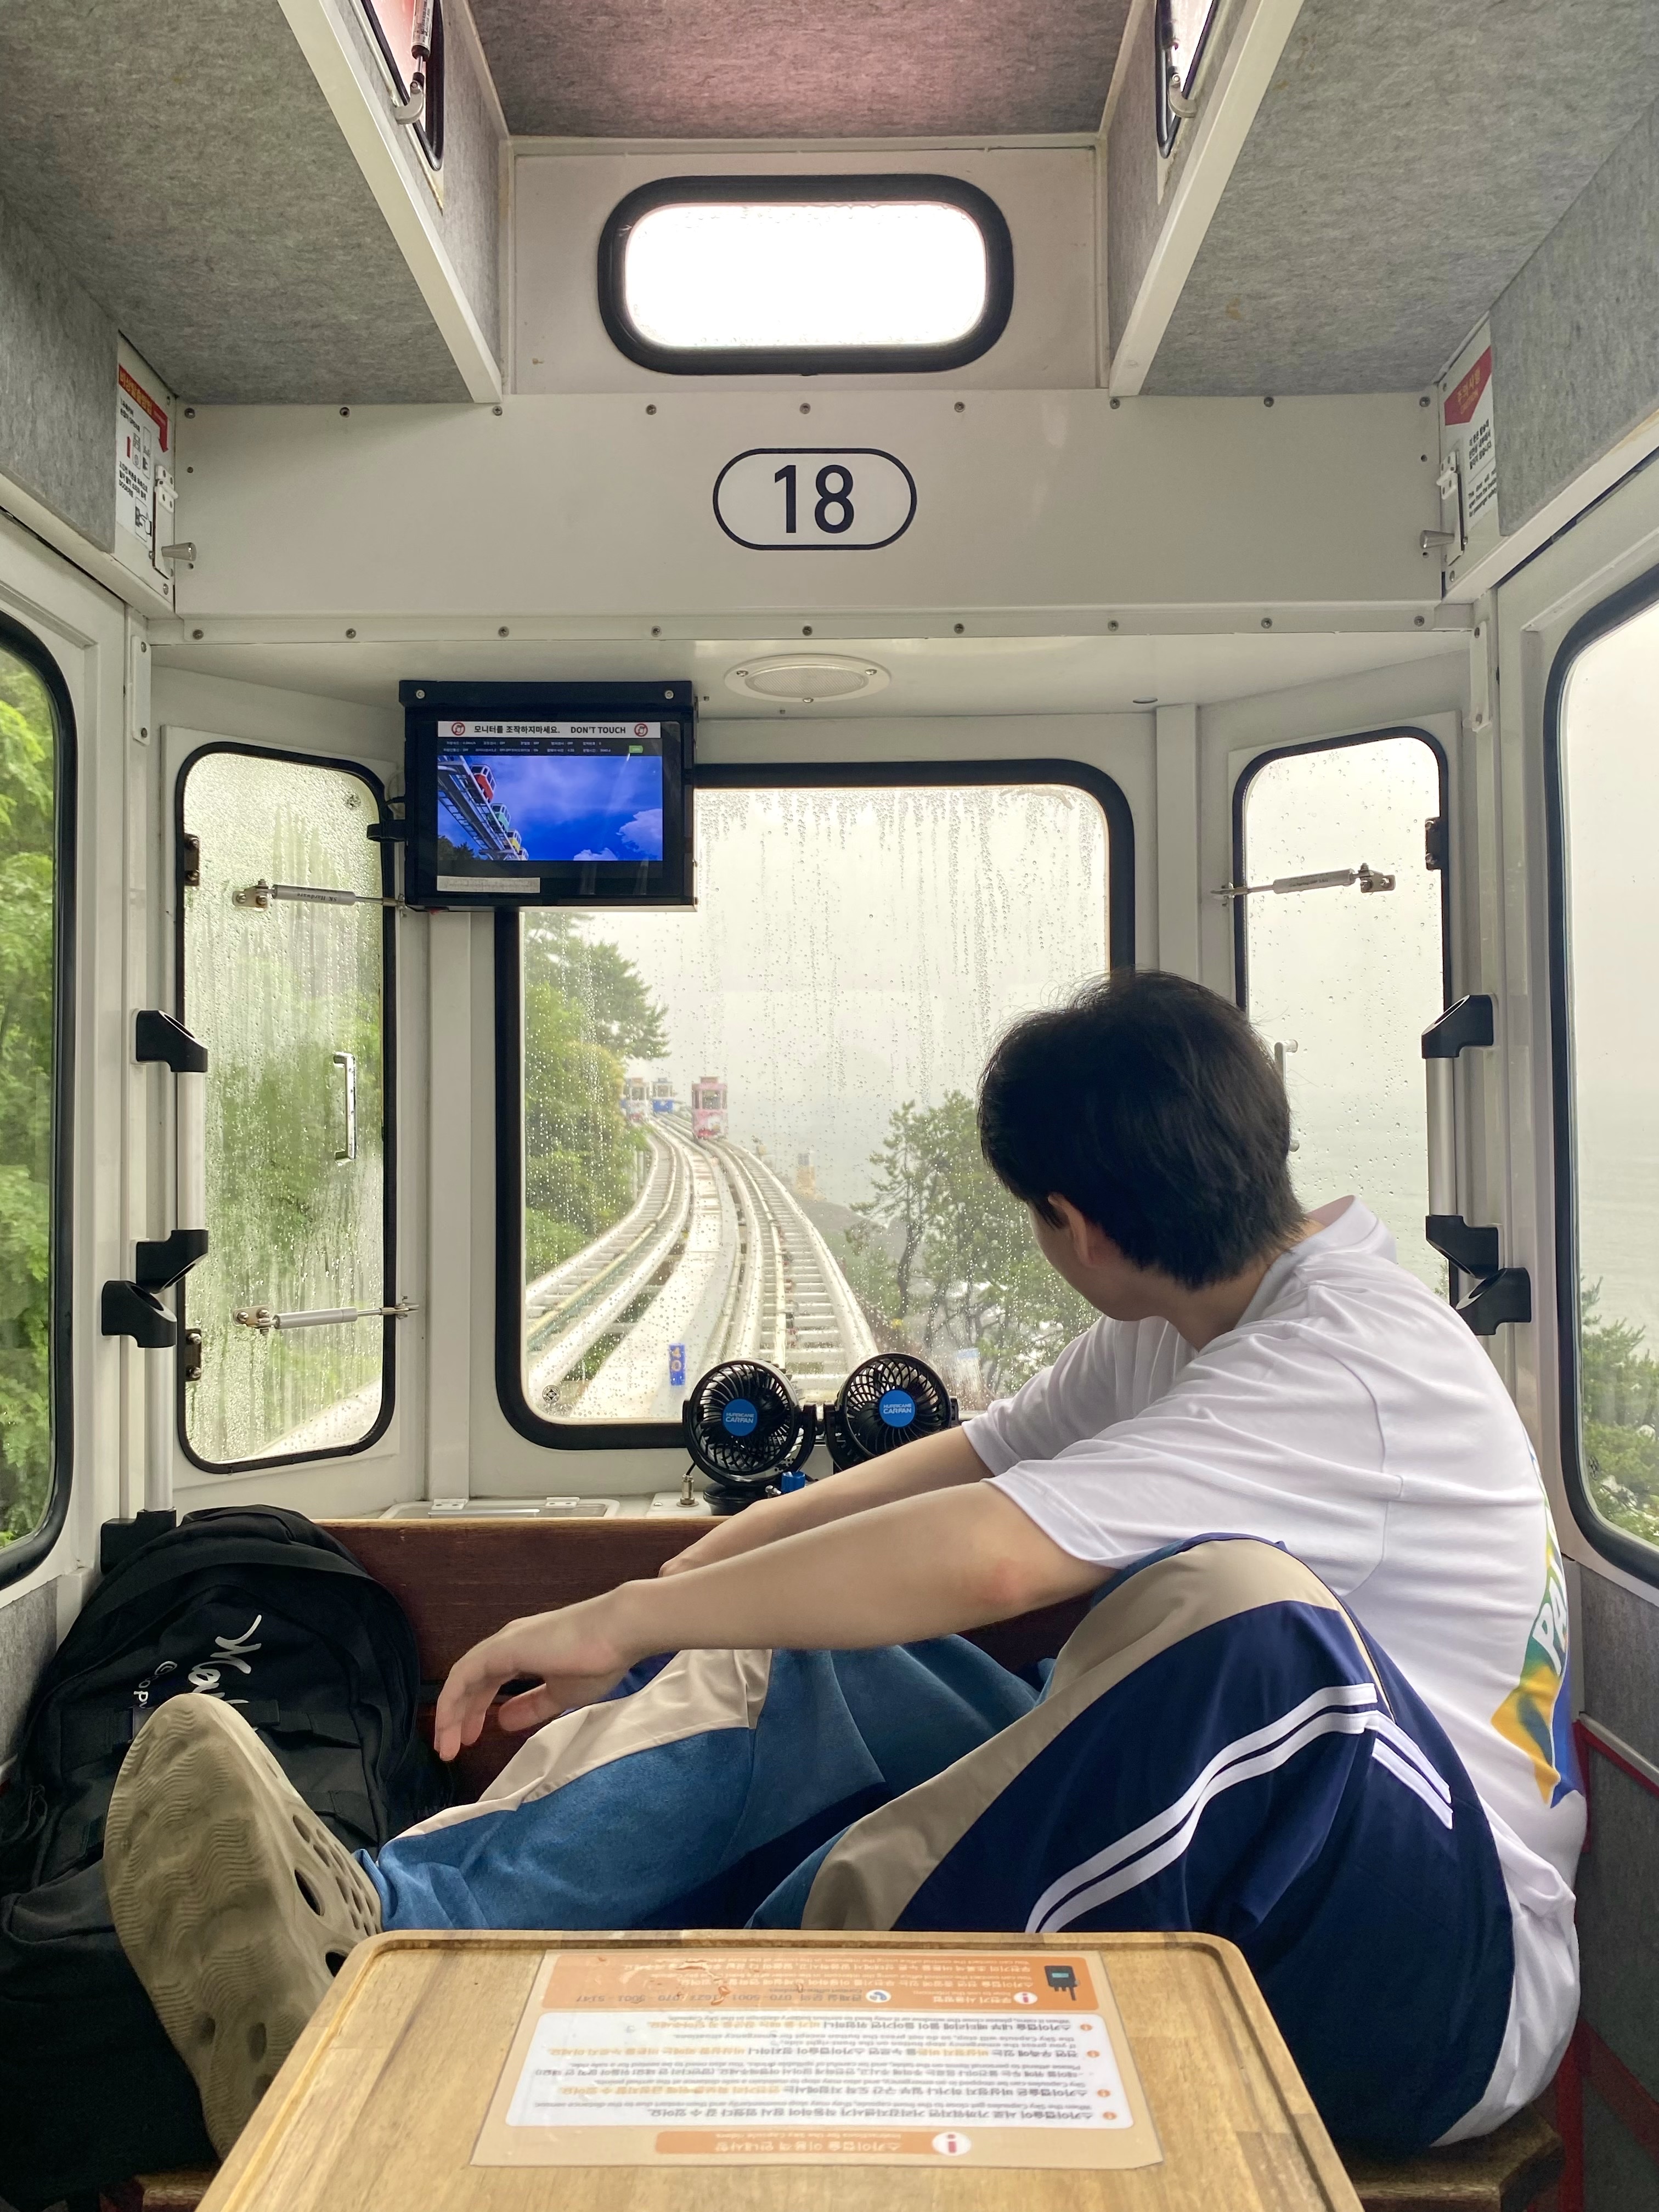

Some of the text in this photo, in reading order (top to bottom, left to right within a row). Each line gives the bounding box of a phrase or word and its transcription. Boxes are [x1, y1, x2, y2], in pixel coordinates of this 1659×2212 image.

[774, 465, 854, 533] 18
[474, 725, 504, 735] 모니터를
[506, 725, 560, 735] 조작하지마세요.
[571, 726, 596, 734] DON'T
[297, 893, 326, 902] Hardware
[715, 2142, 900, 2152] 스카이캡슐 이용객 안내사항
